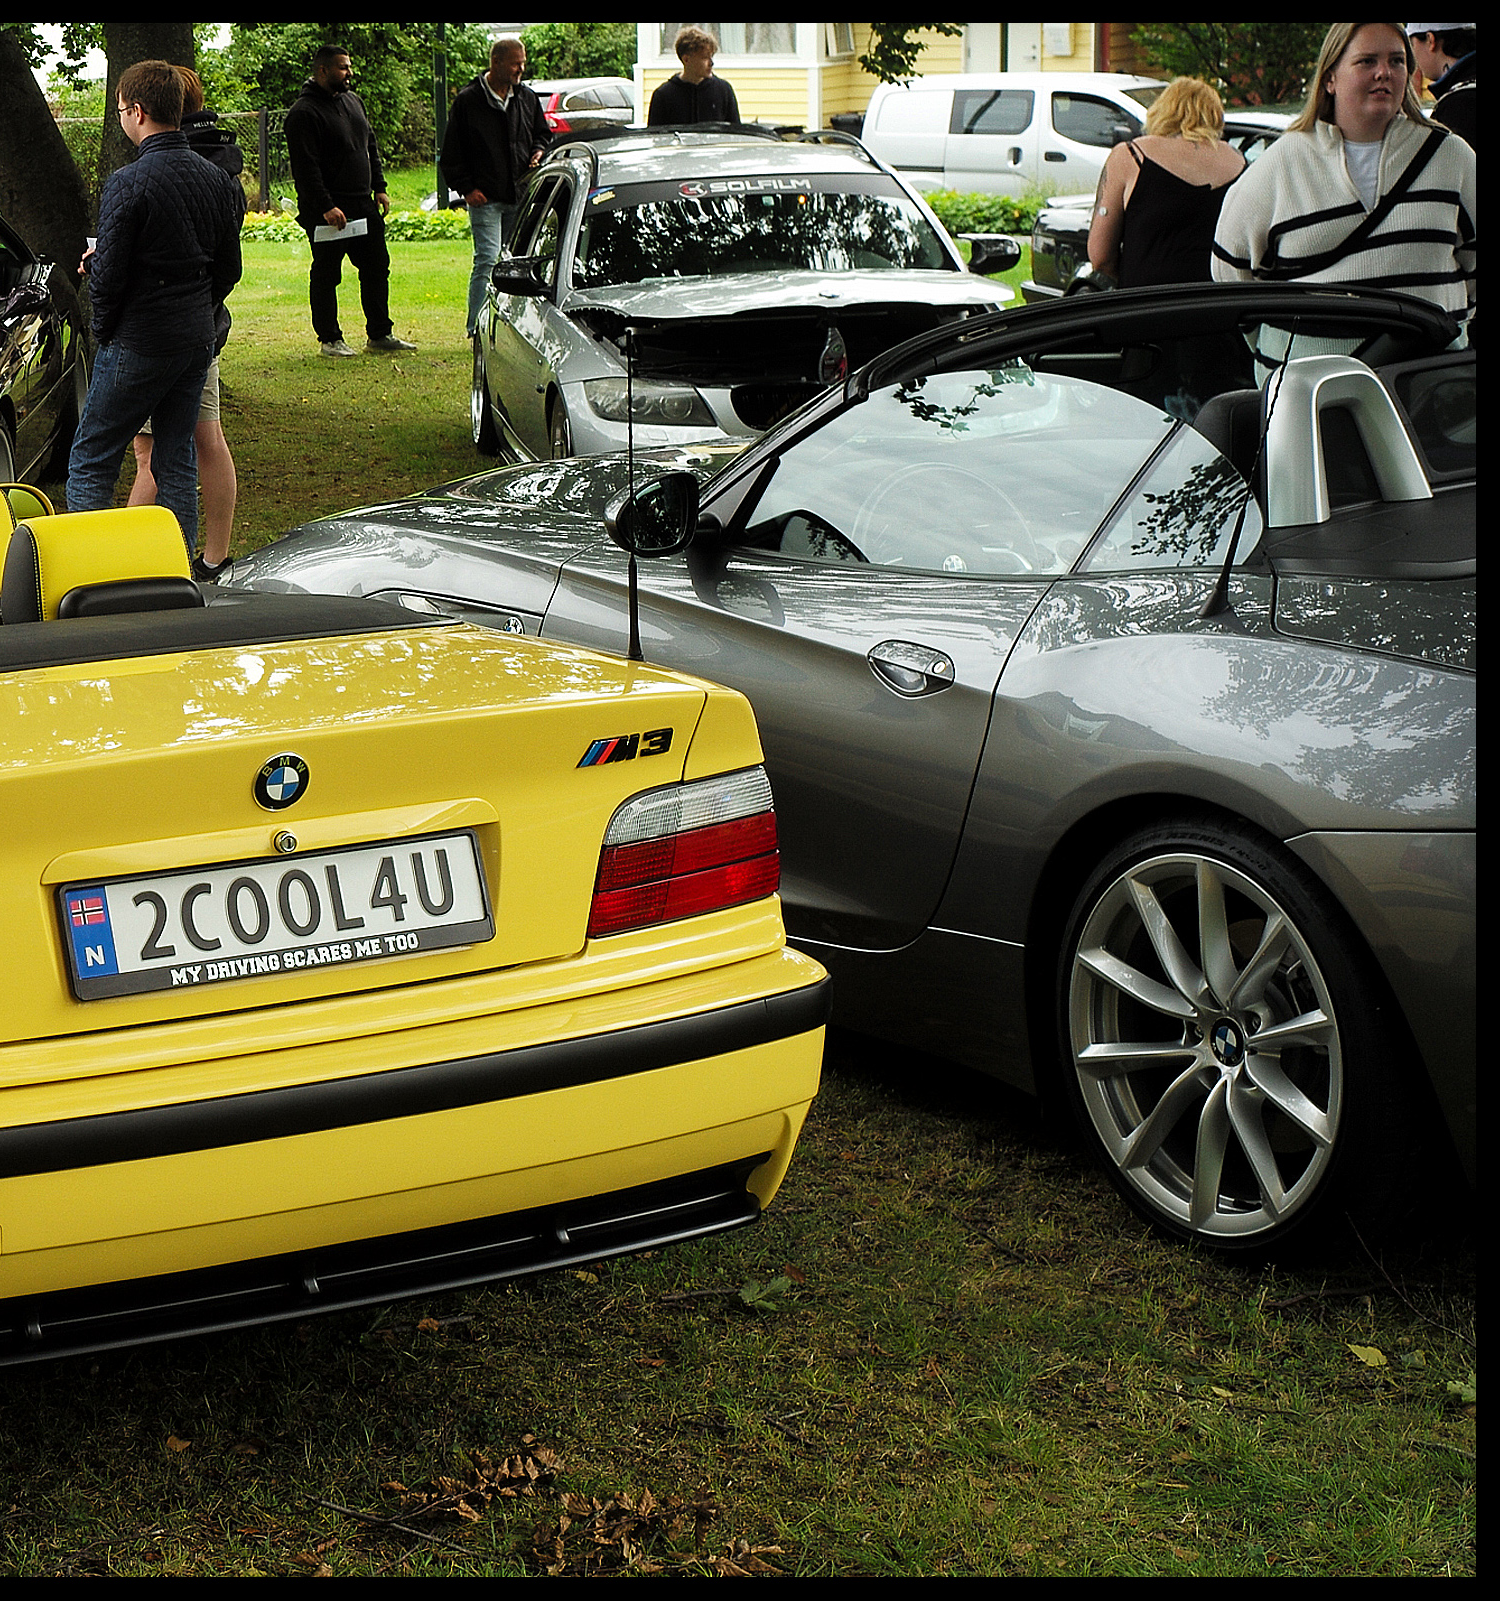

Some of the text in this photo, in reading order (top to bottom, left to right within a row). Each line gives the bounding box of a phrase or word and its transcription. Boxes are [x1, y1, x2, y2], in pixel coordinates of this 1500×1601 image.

[709, 179, 812, 193] SOLFILM
[598, 727, 674, 765] M3
[261, 756, 307, 777] BMW
[132, 848, 455, 961] 2COOL4U
[85, 944, 106, 967] N
[170, 933, 419, 986] MY DRIVING SCARES ME TOO
